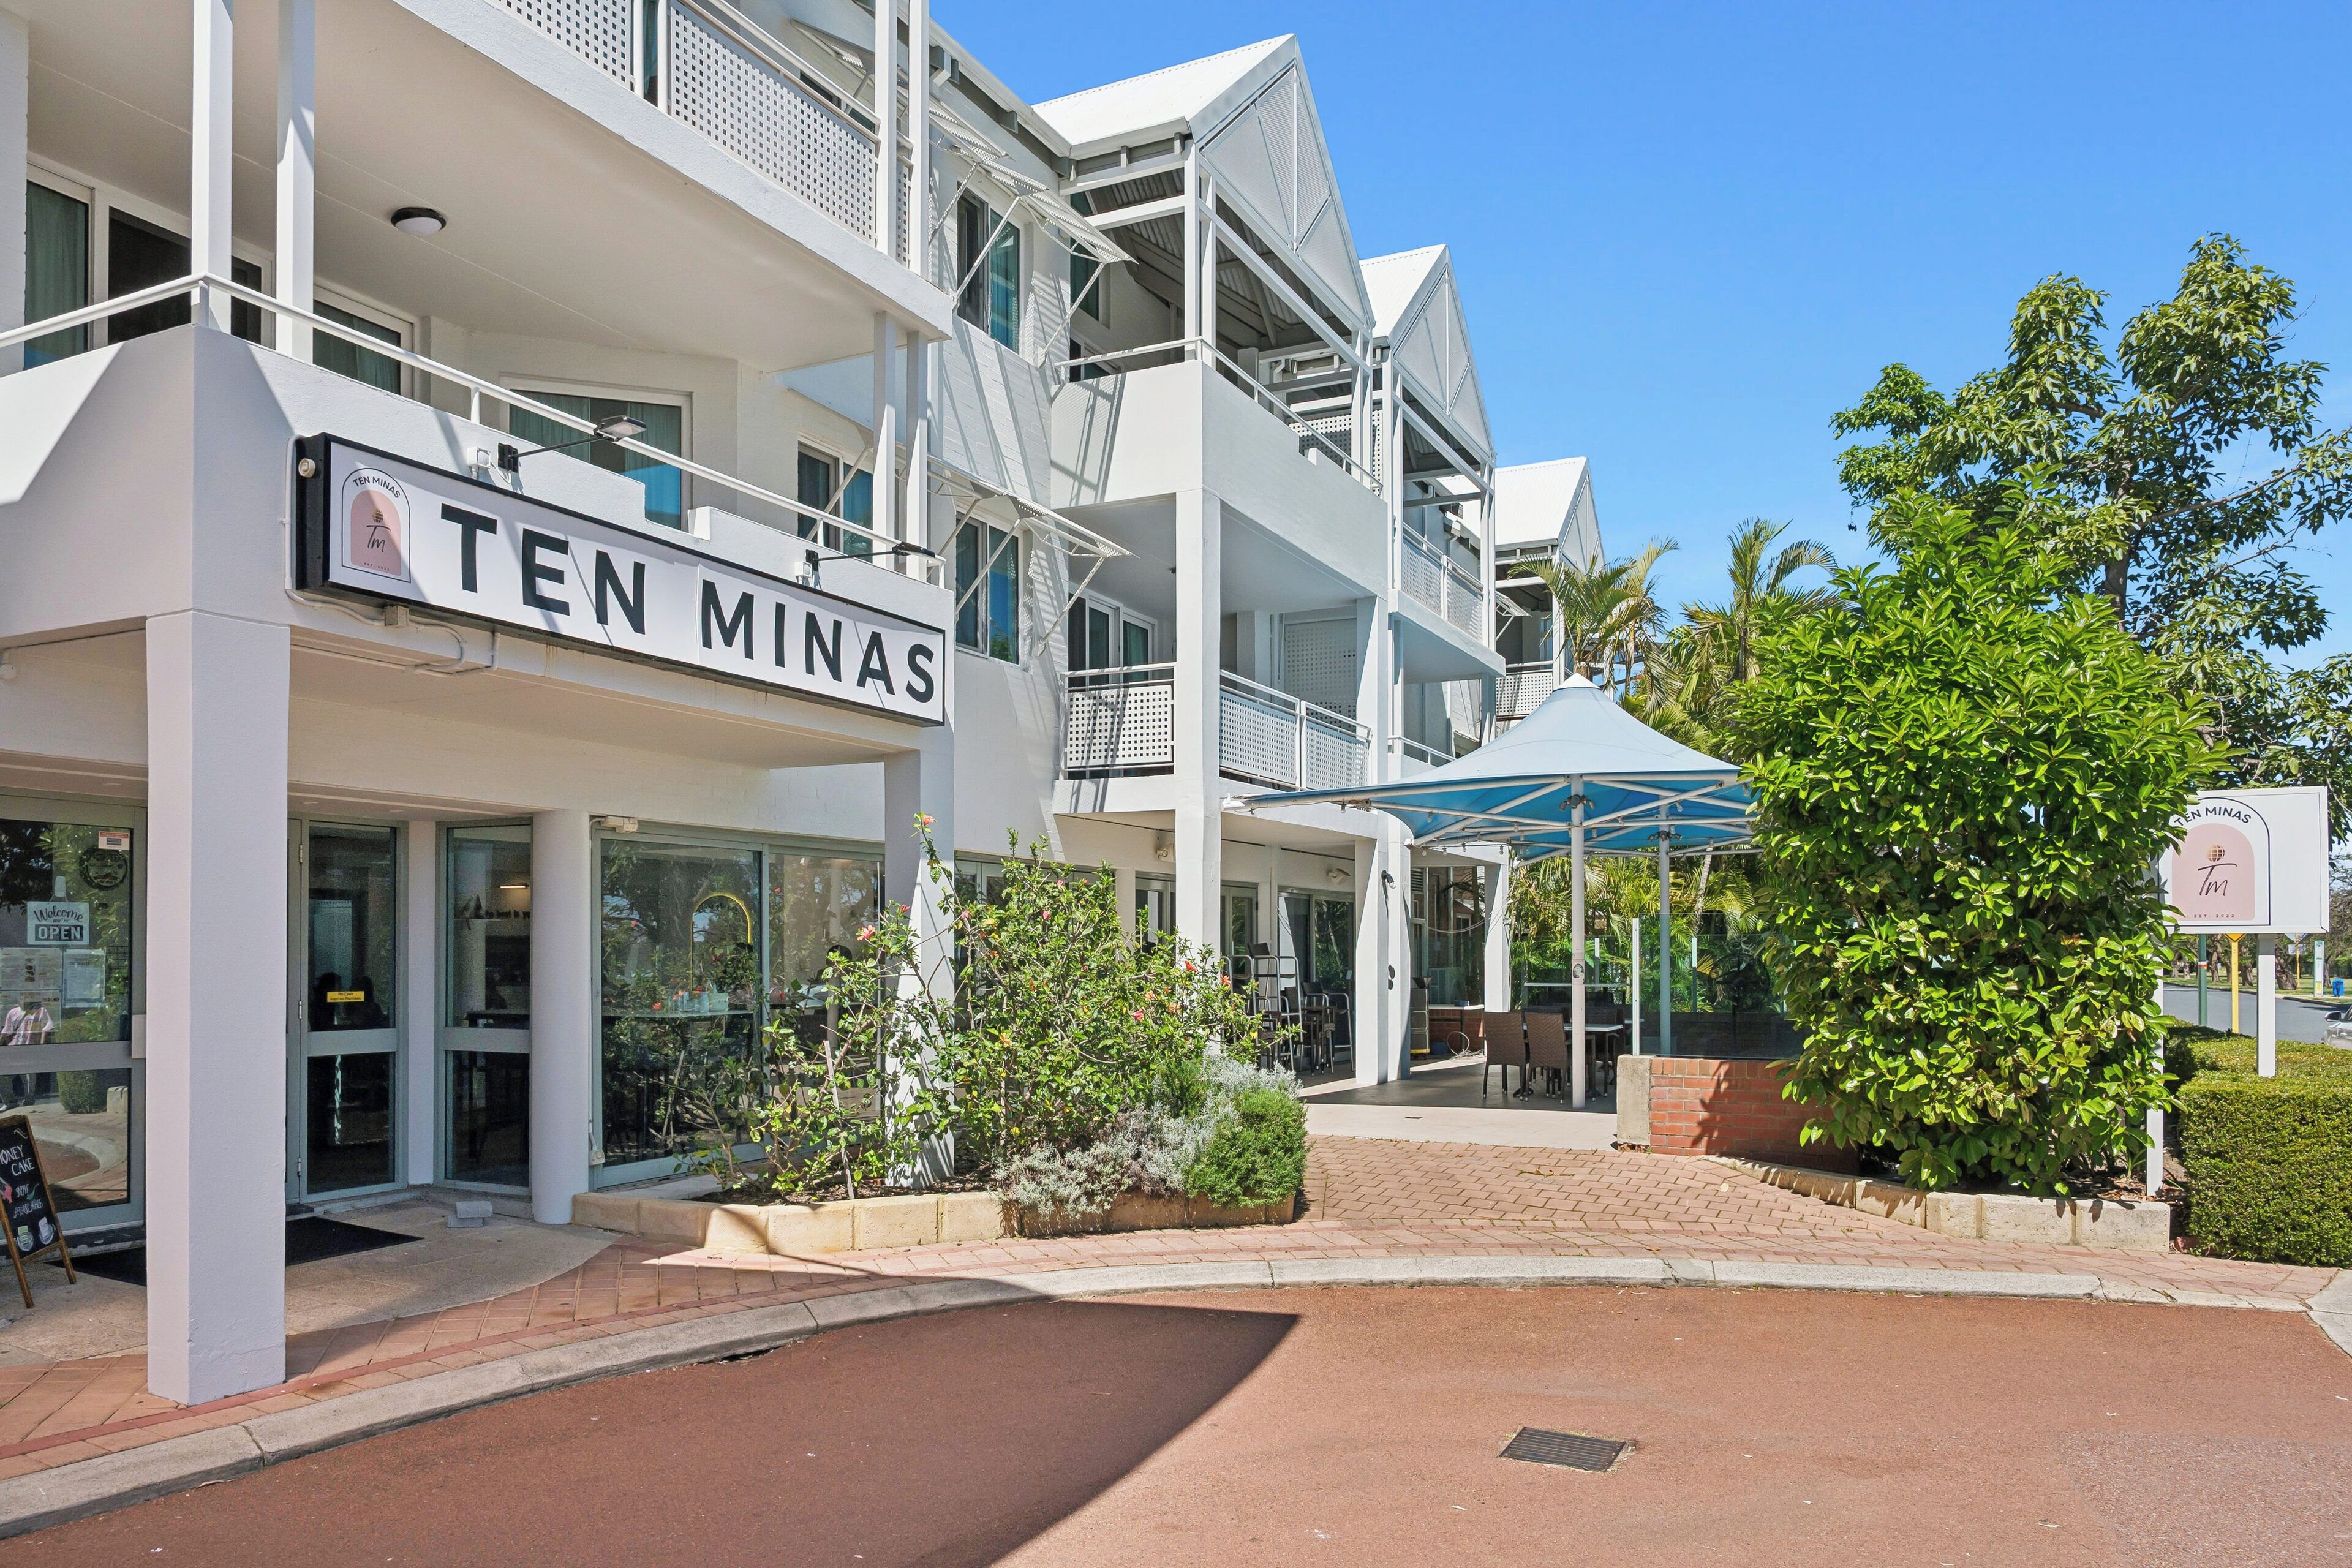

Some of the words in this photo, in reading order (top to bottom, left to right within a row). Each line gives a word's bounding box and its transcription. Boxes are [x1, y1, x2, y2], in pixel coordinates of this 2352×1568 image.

[352, 475, 371, 488] TEN
[372, 476, 401, 499] MINAS
[440, 502, 646, 635] TEN
[701, 578, 935, 703] MINAS
[2205, 806, 2252, 824] MINAS
[33, 905, 83, 922] Welcome
[38, 926, 81, 940] OPEN
[11, 1157, 35, 1176] CAKE
